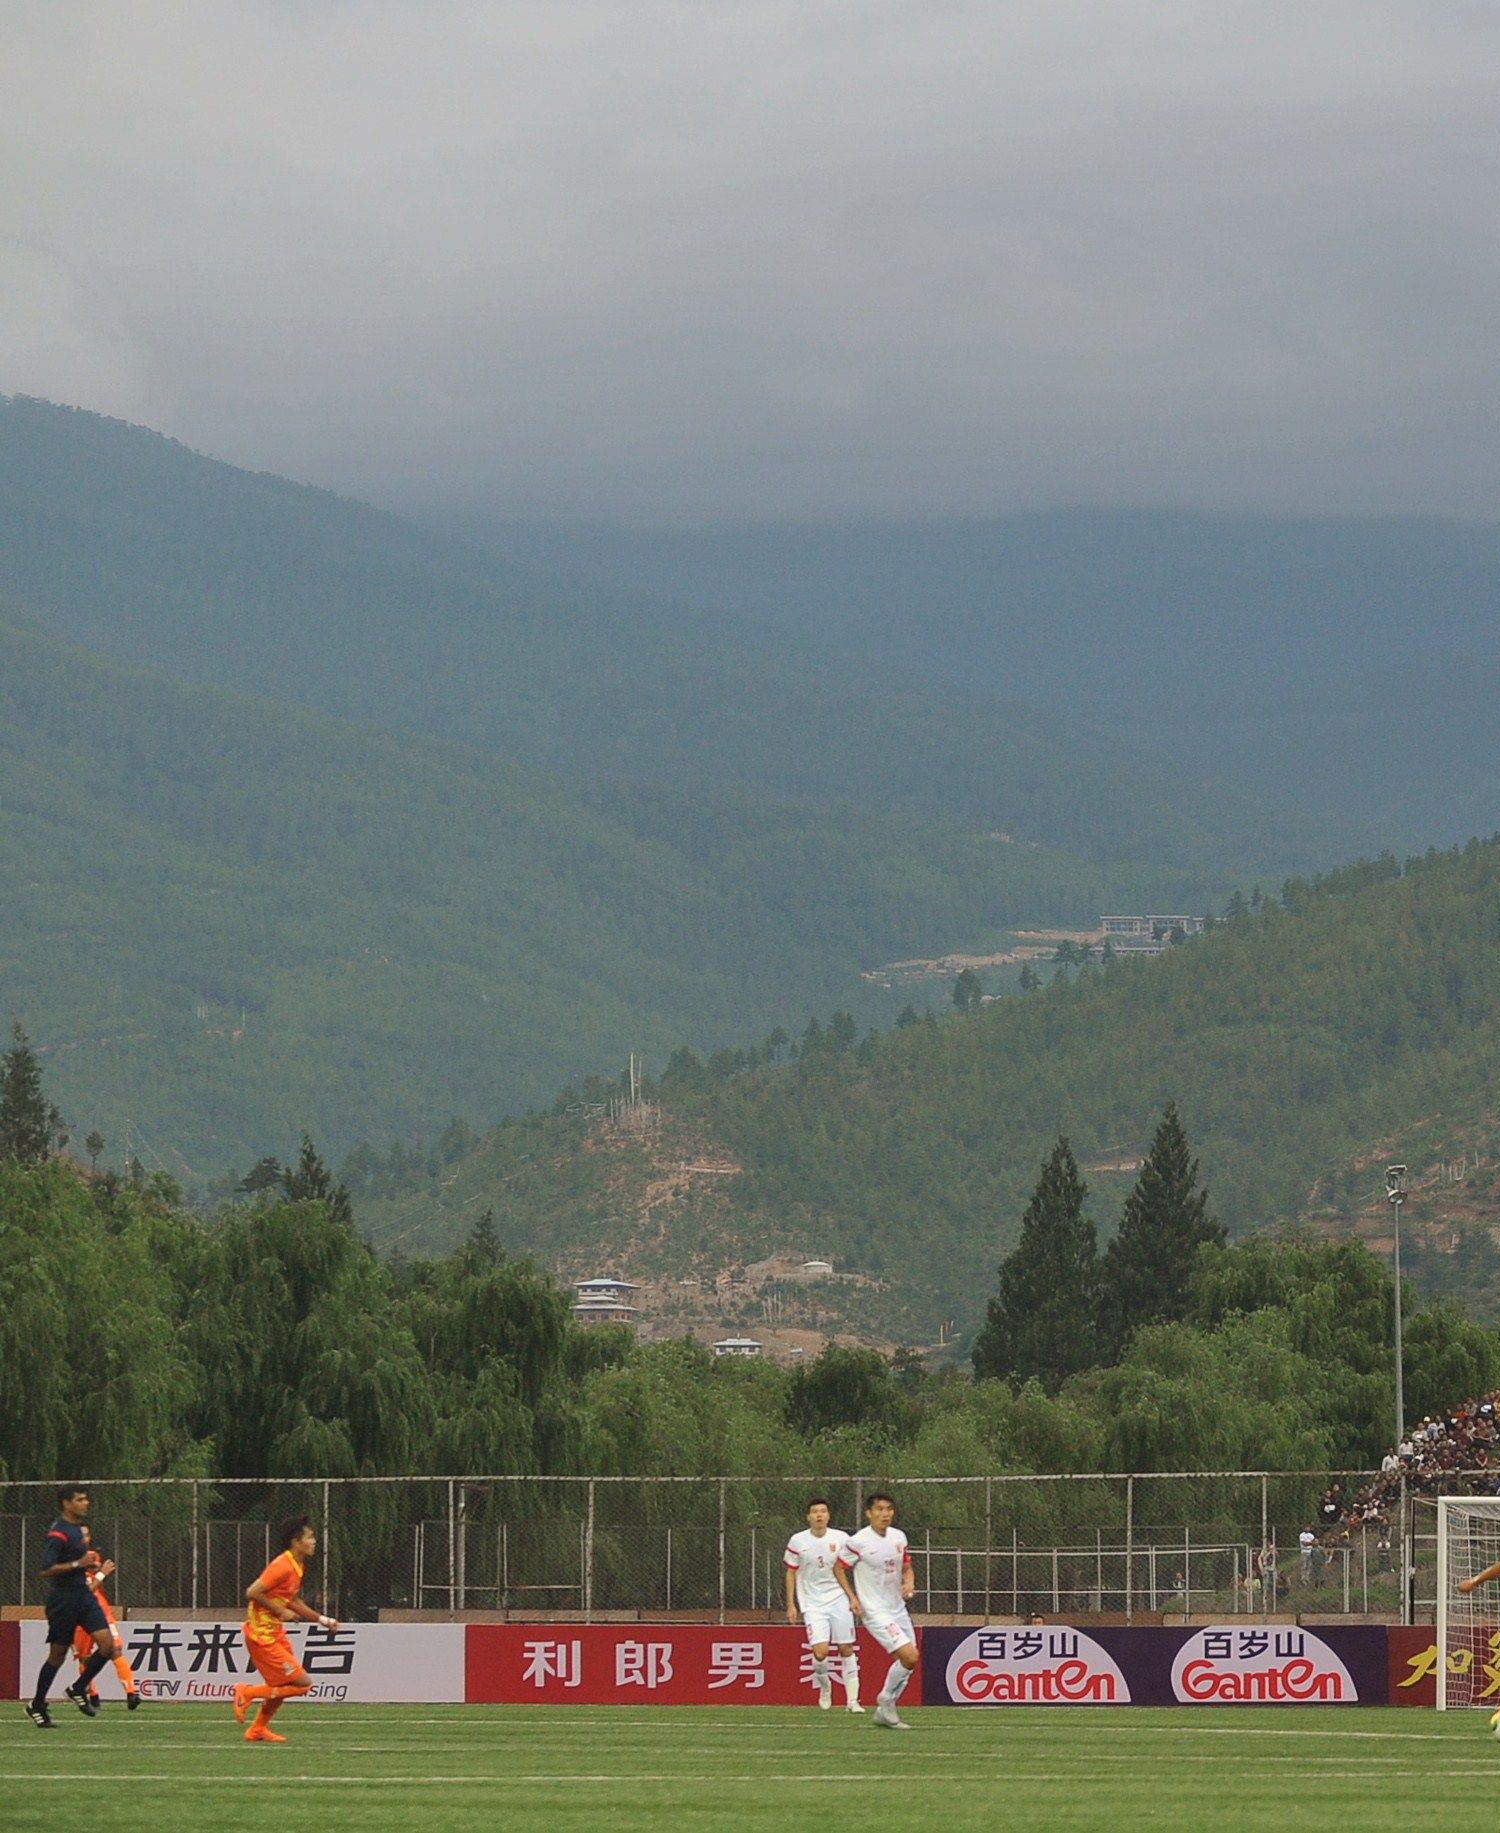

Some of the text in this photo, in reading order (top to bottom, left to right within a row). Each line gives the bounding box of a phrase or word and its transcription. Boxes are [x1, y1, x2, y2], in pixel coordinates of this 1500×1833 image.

[127, 1623, 356, 1674] 未来告
[978, 1631, 1079, 1661] 百岁山
[1203, 1631, 1305, 1660] 百岁山
